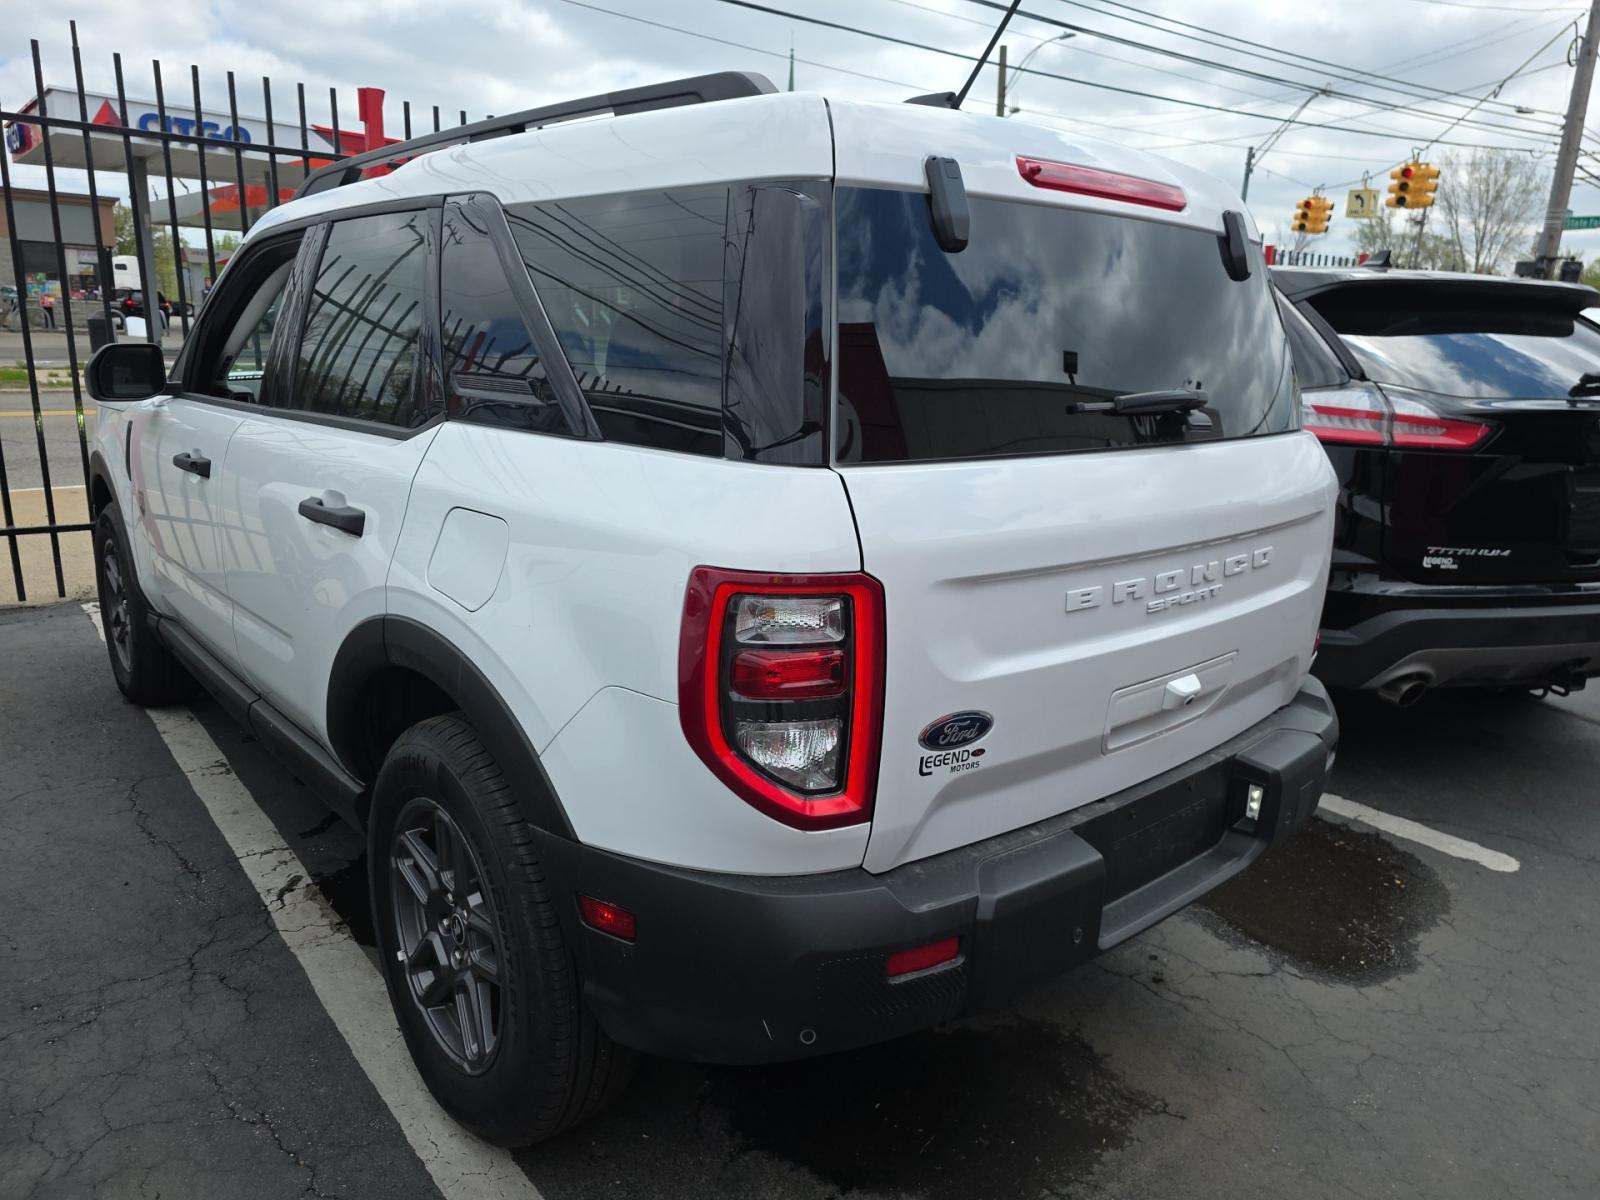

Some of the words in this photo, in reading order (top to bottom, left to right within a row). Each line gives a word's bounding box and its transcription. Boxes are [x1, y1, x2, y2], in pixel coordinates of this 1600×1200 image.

[1066, 545, 1274, 613] BRONCO
[1147, 583, 1224, 613] SPORT
[939, 719, 980, 745] Ford
[919, 749, 971, 777] LEGEND
[950, 760, 982, 774] MOTORS
